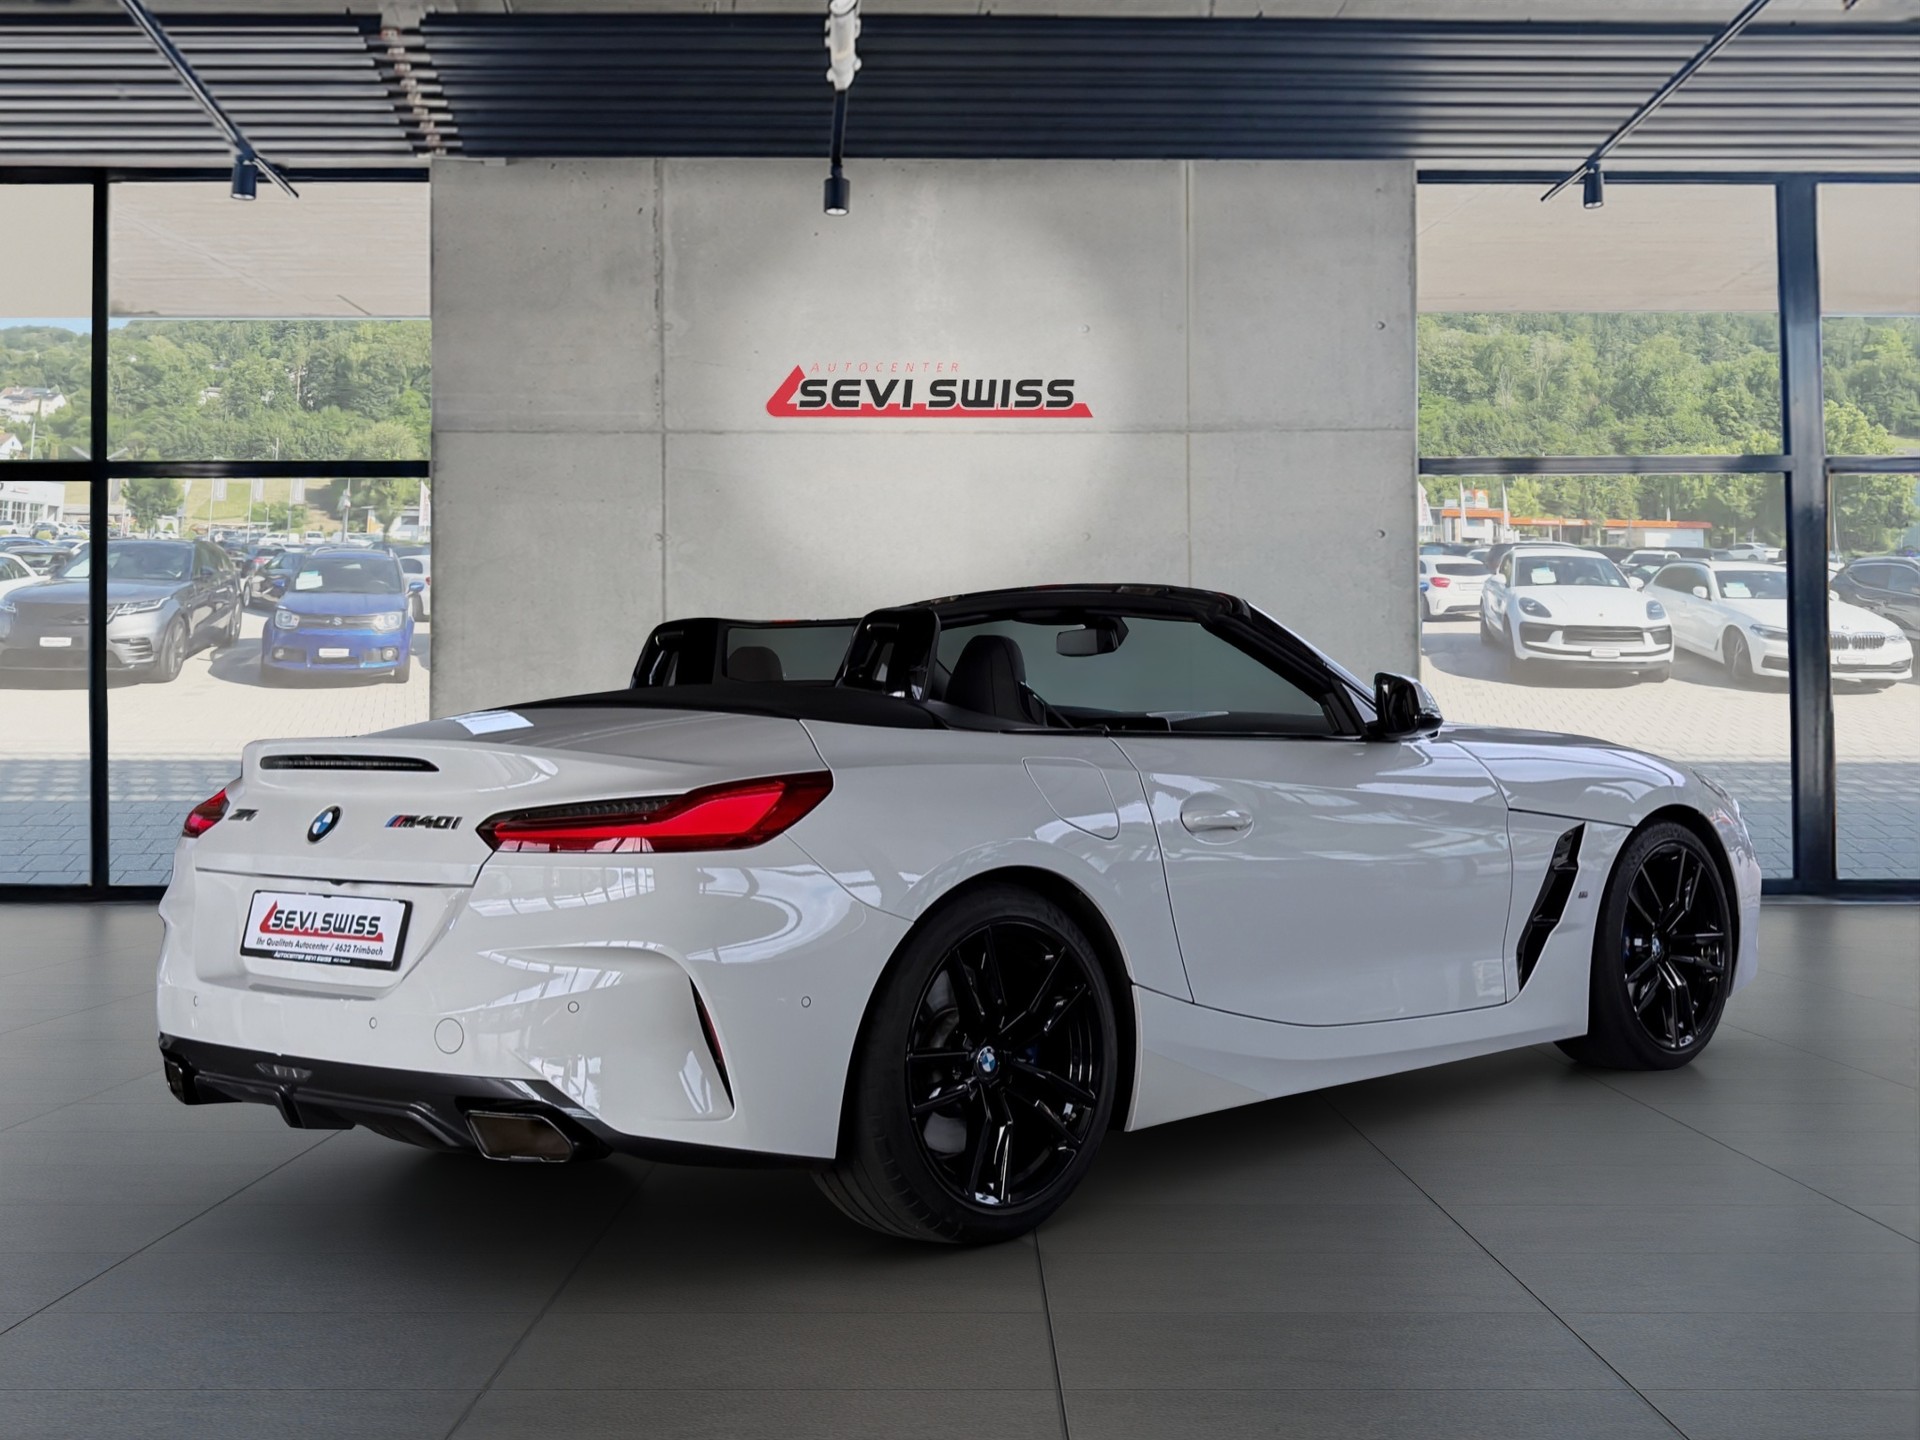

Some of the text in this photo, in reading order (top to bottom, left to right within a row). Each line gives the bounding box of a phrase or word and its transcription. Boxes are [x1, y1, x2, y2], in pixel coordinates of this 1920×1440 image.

[811, 362, 960, 373] AUTOCENTER
[798, 379, 1076, 409] SEVI SWISS
[271, 910, 381, 935] SEVI SWISS
[256, 937, 265, 945] Ihr
[295, 940, 329, 951] Autocenter
[335, 944, 351, 953] 4632
[352, 944, 384, 956] Trimbach
